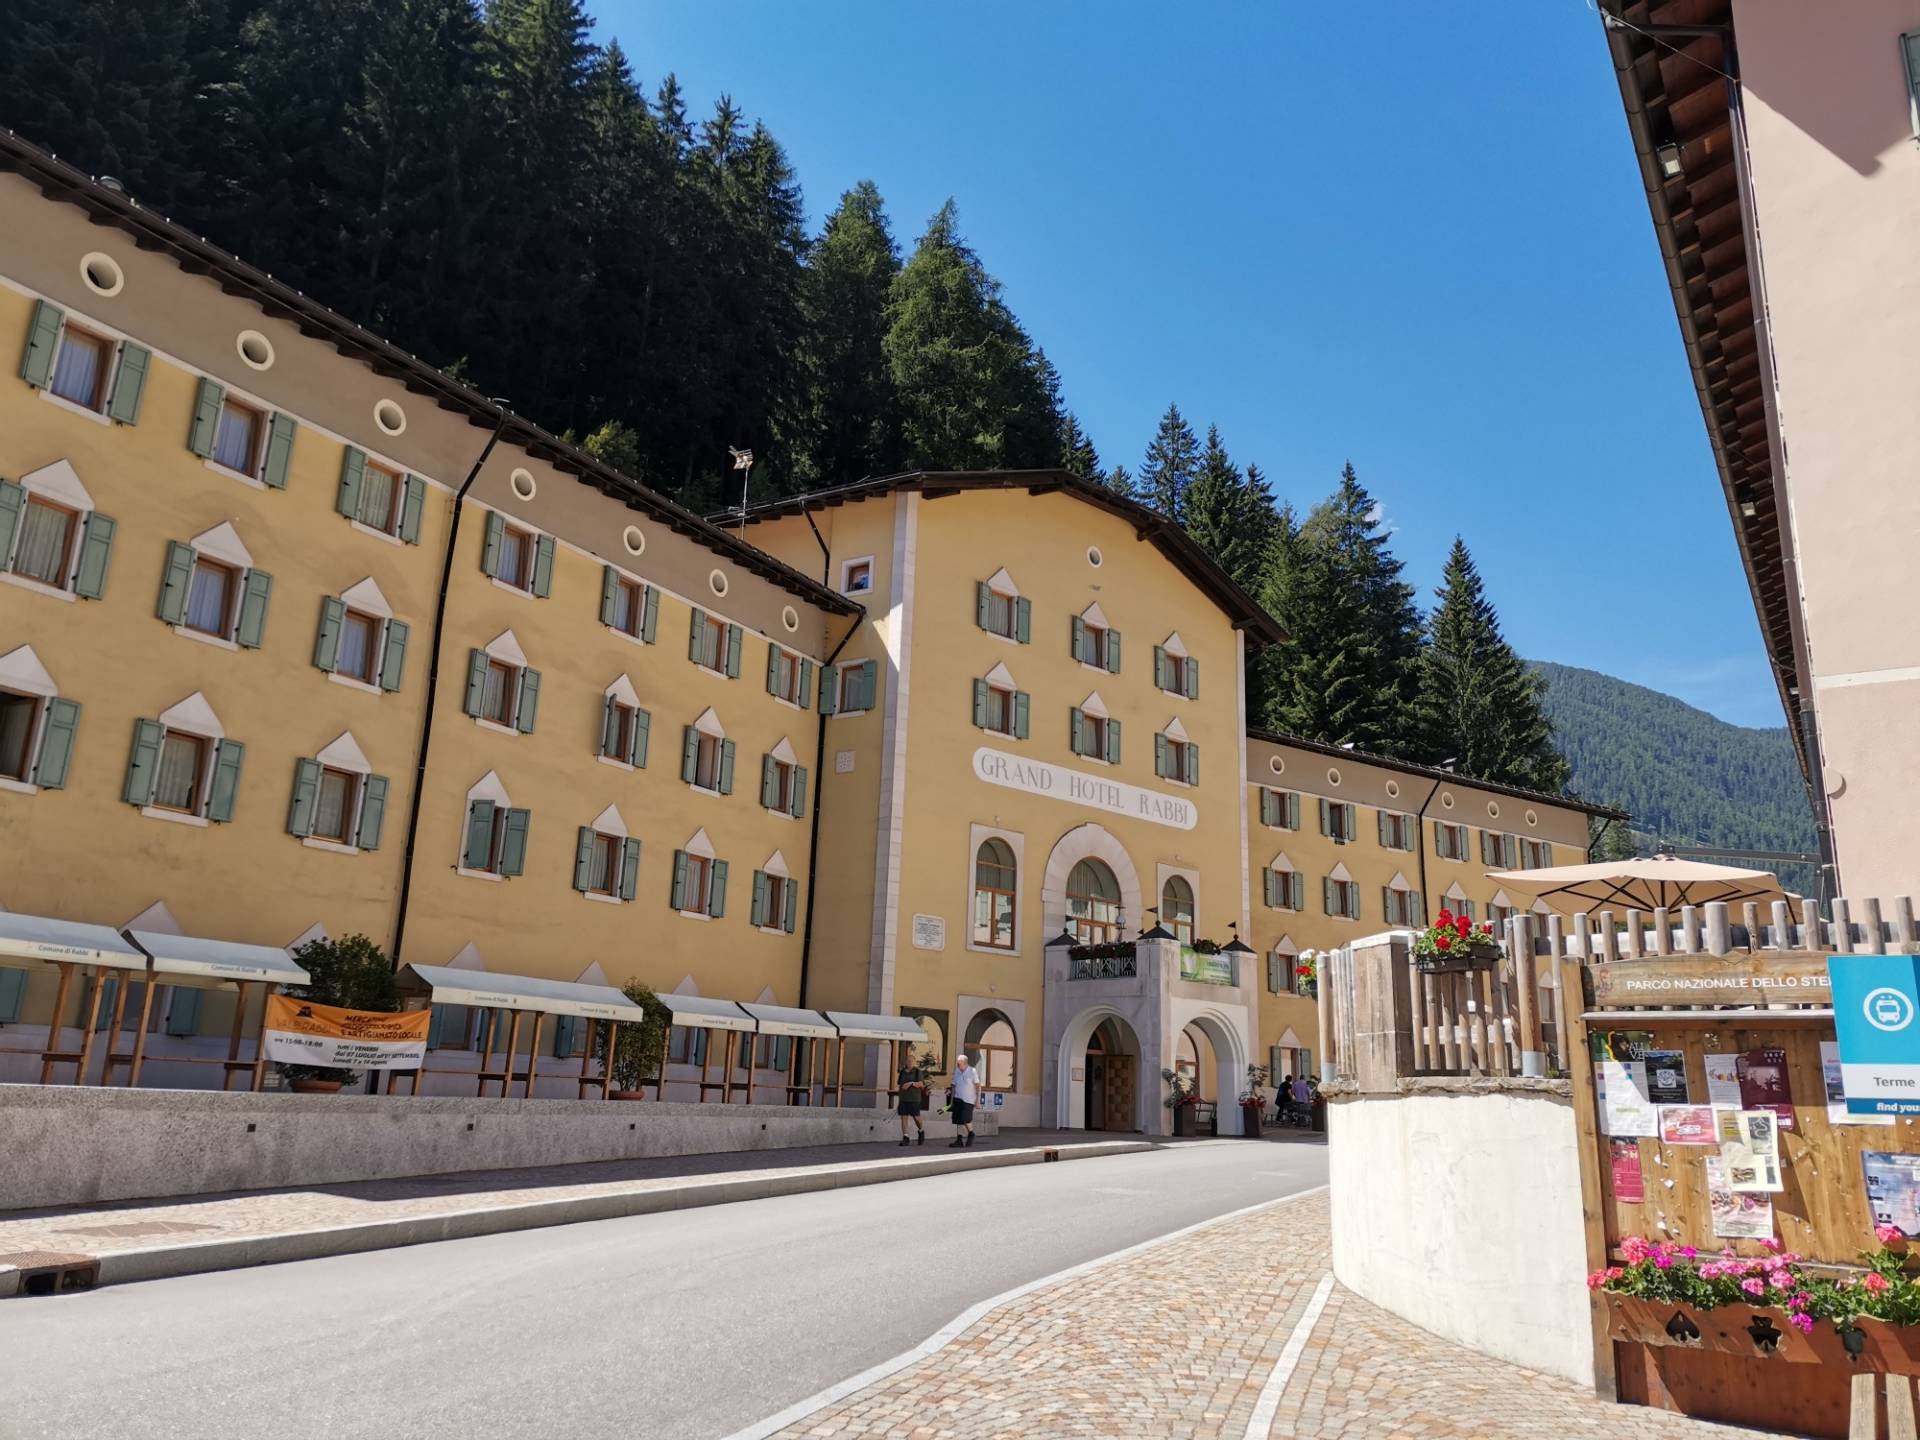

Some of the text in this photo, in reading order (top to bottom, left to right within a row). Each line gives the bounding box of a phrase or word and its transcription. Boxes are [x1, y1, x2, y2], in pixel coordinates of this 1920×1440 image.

[981, 753, 1188, 825] GRAND HOTEL RABBI
[1627, 976, 1832, 990] PARCO NAZIONALE DELLO STE
[1873, 1077, 1916, 1087] Terme
[1876, 1102, 1898, 1111] find
